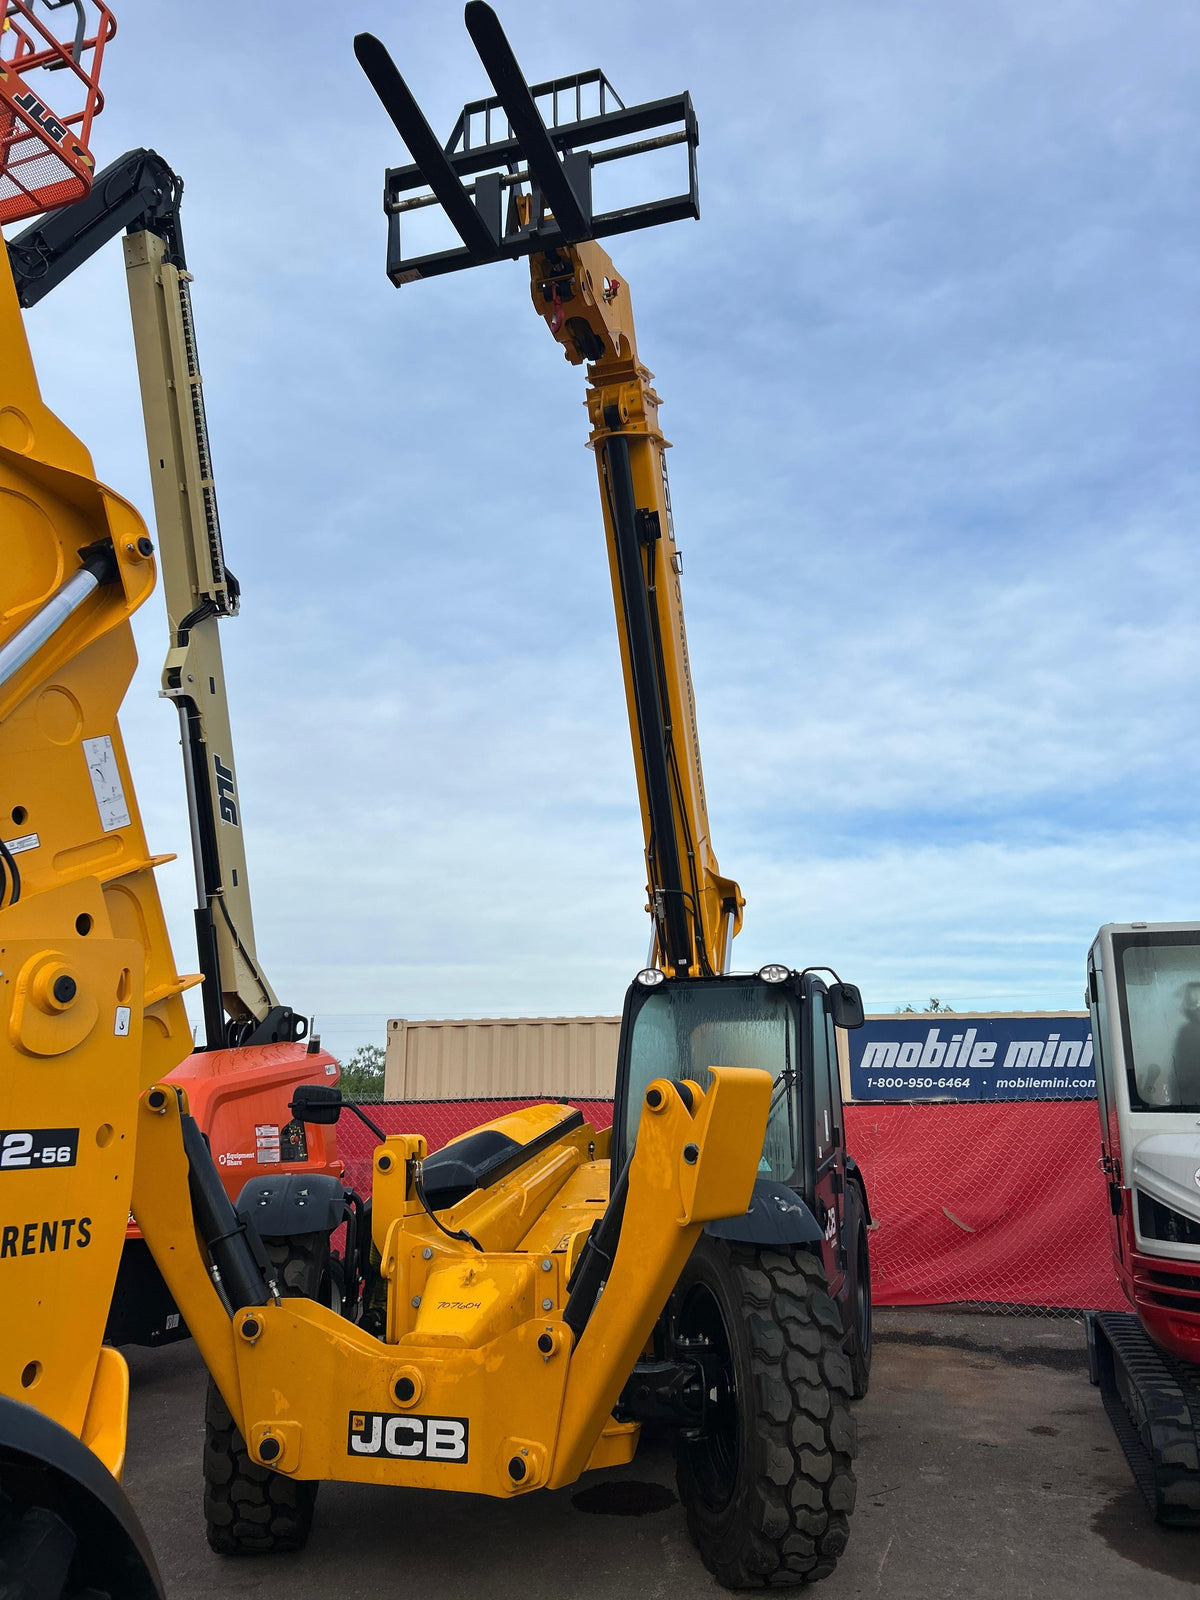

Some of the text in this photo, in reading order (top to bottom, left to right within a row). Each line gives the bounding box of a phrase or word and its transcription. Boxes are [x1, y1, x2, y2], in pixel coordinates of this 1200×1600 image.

[12, 91, 69, 145] JLG
[213, 752, 239, 828] JLG
[860, 1028, 1093, 1068] mobile mini
[867, 1077, 971, 1089] 1-800-950-6464
[0, 1133, 71, 1167] 2-56
[226, 1152, 255, 1160] Equipment
[0, 1217, 92, 1259] RENTS
[437, 1301, 482, 1310] 707604
[351, 1416, 466, 1459] JCB
